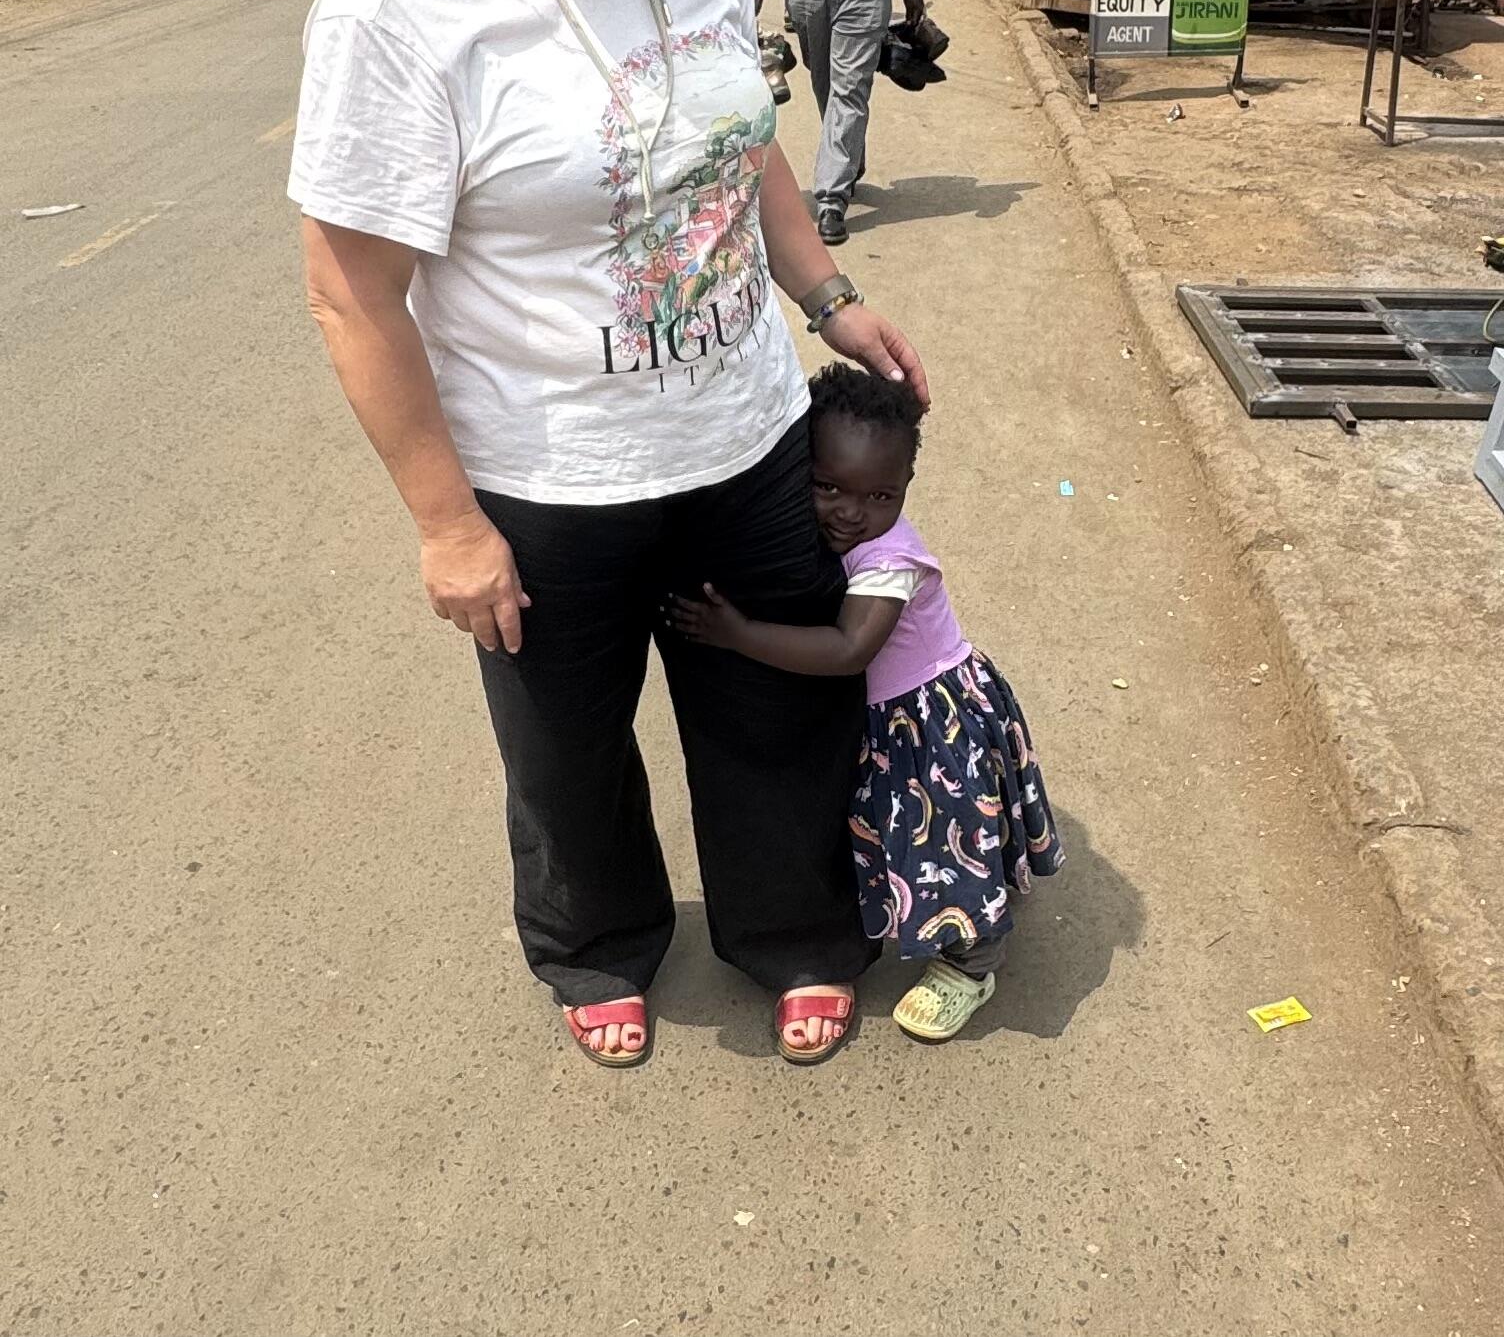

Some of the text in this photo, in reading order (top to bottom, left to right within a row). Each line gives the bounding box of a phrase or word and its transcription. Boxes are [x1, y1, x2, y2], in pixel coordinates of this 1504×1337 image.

[1175, 1, 1239, 19] JIRANI
[1106, 25, 1154, 43] AGENT
[597, 277, 762, 374] LIGUR
